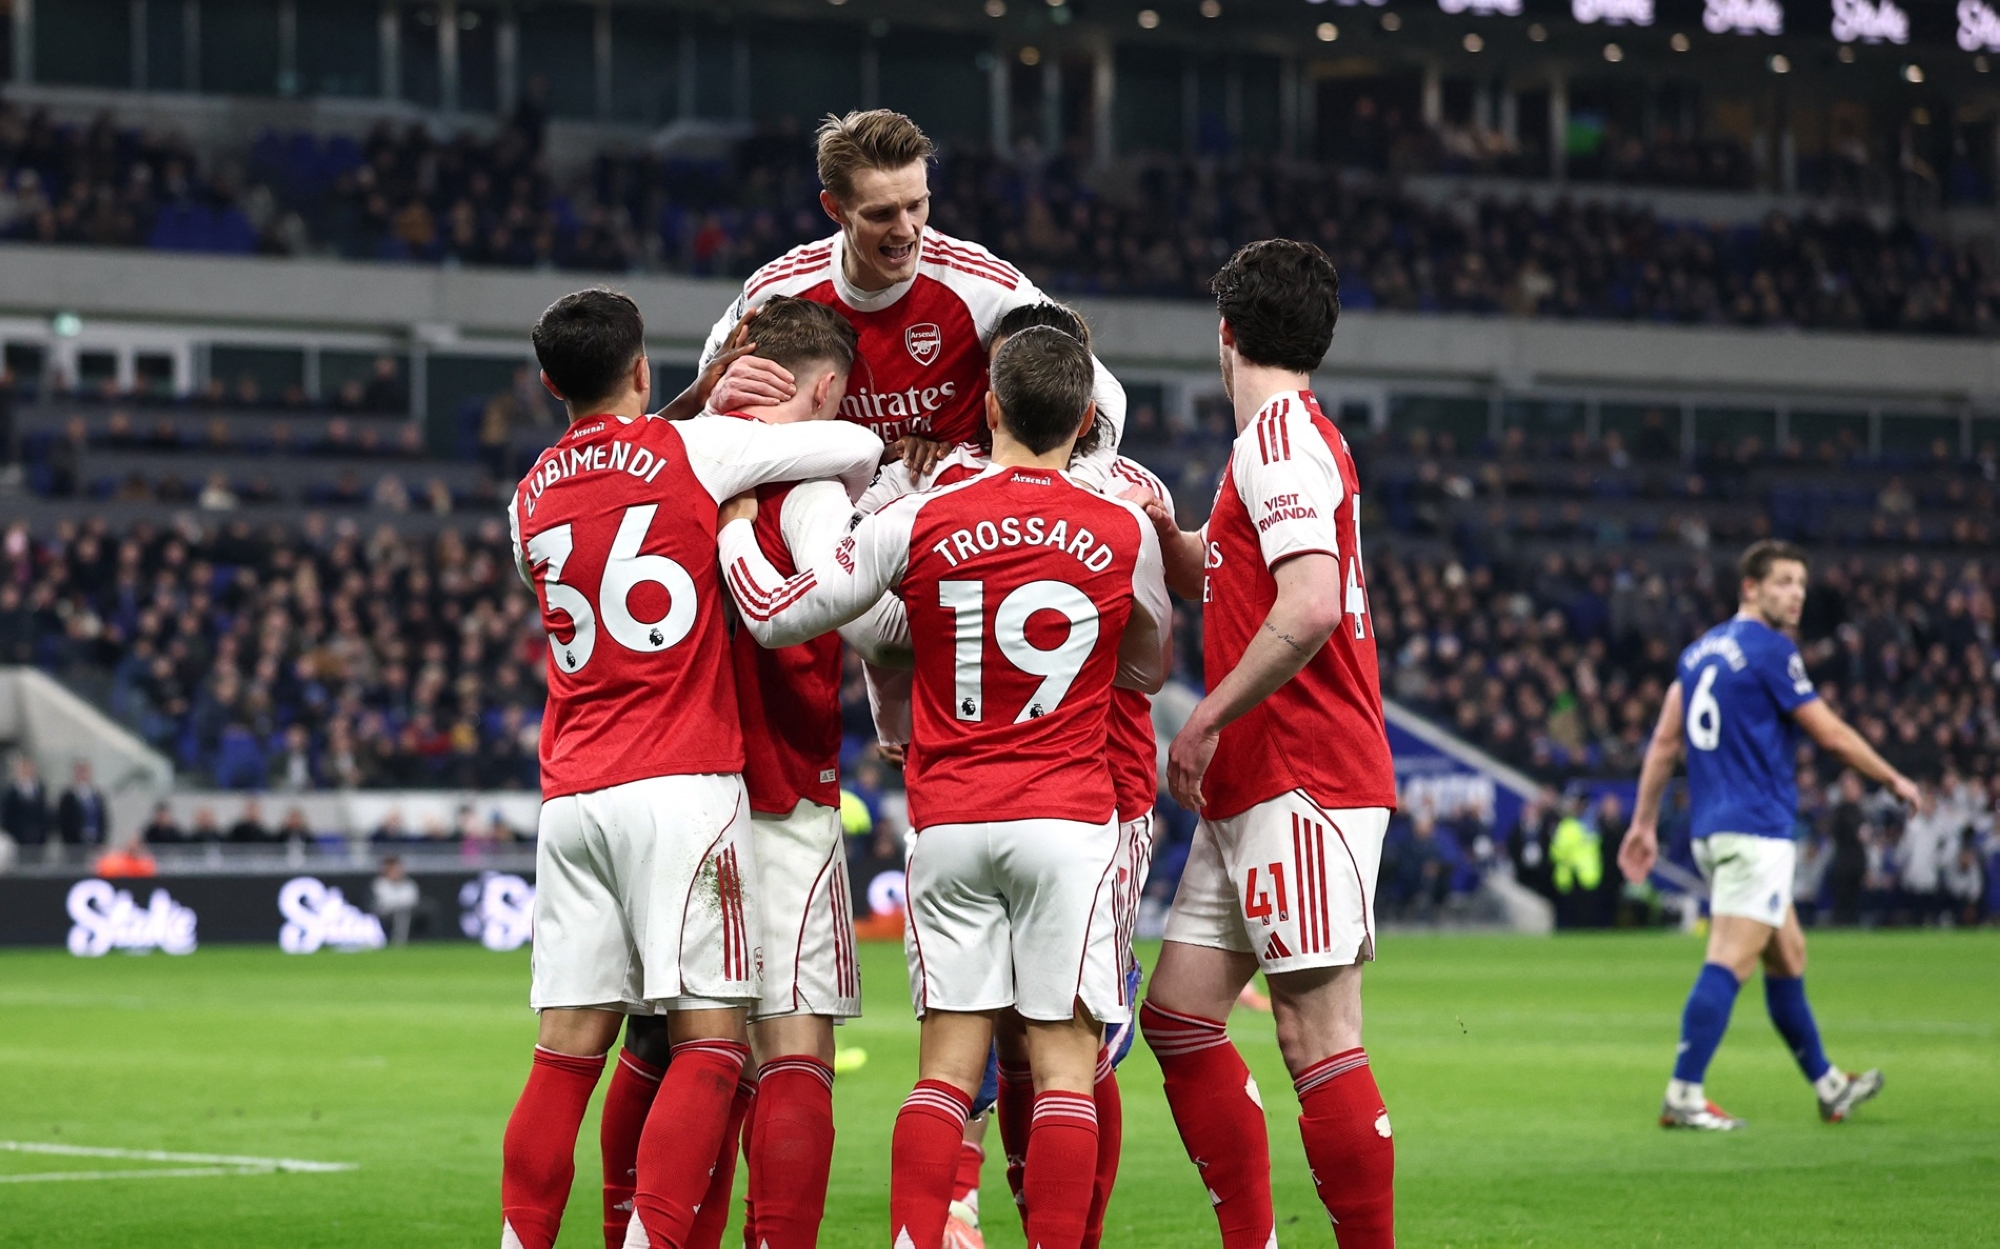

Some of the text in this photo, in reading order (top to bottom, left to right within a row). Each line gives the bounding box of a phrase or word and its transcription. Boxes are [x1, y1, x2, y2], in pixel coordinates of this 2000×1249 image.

[911, 330, 937, 339] Arsenal
[838, 381, 956, 418] mirates
[572, 421, 605, 440] Arsenal
[524, 440, 667, 518] ZUBIMENDI
[1010, 472, 1051, 486] Arsenal
[1258, 507, 1318, 533] RWANDA
[1264, 493, 1299, 512] VISIT
[835, 547, 855, 575] NDA
[932, 517, 1114, 574] TROSSARD
[526, 503, 698, 674] 36
[938, 579, 1100, 726] 19
[1686, 663, 1721, 752] 6
[1245, 862, 1289, 926] 41
